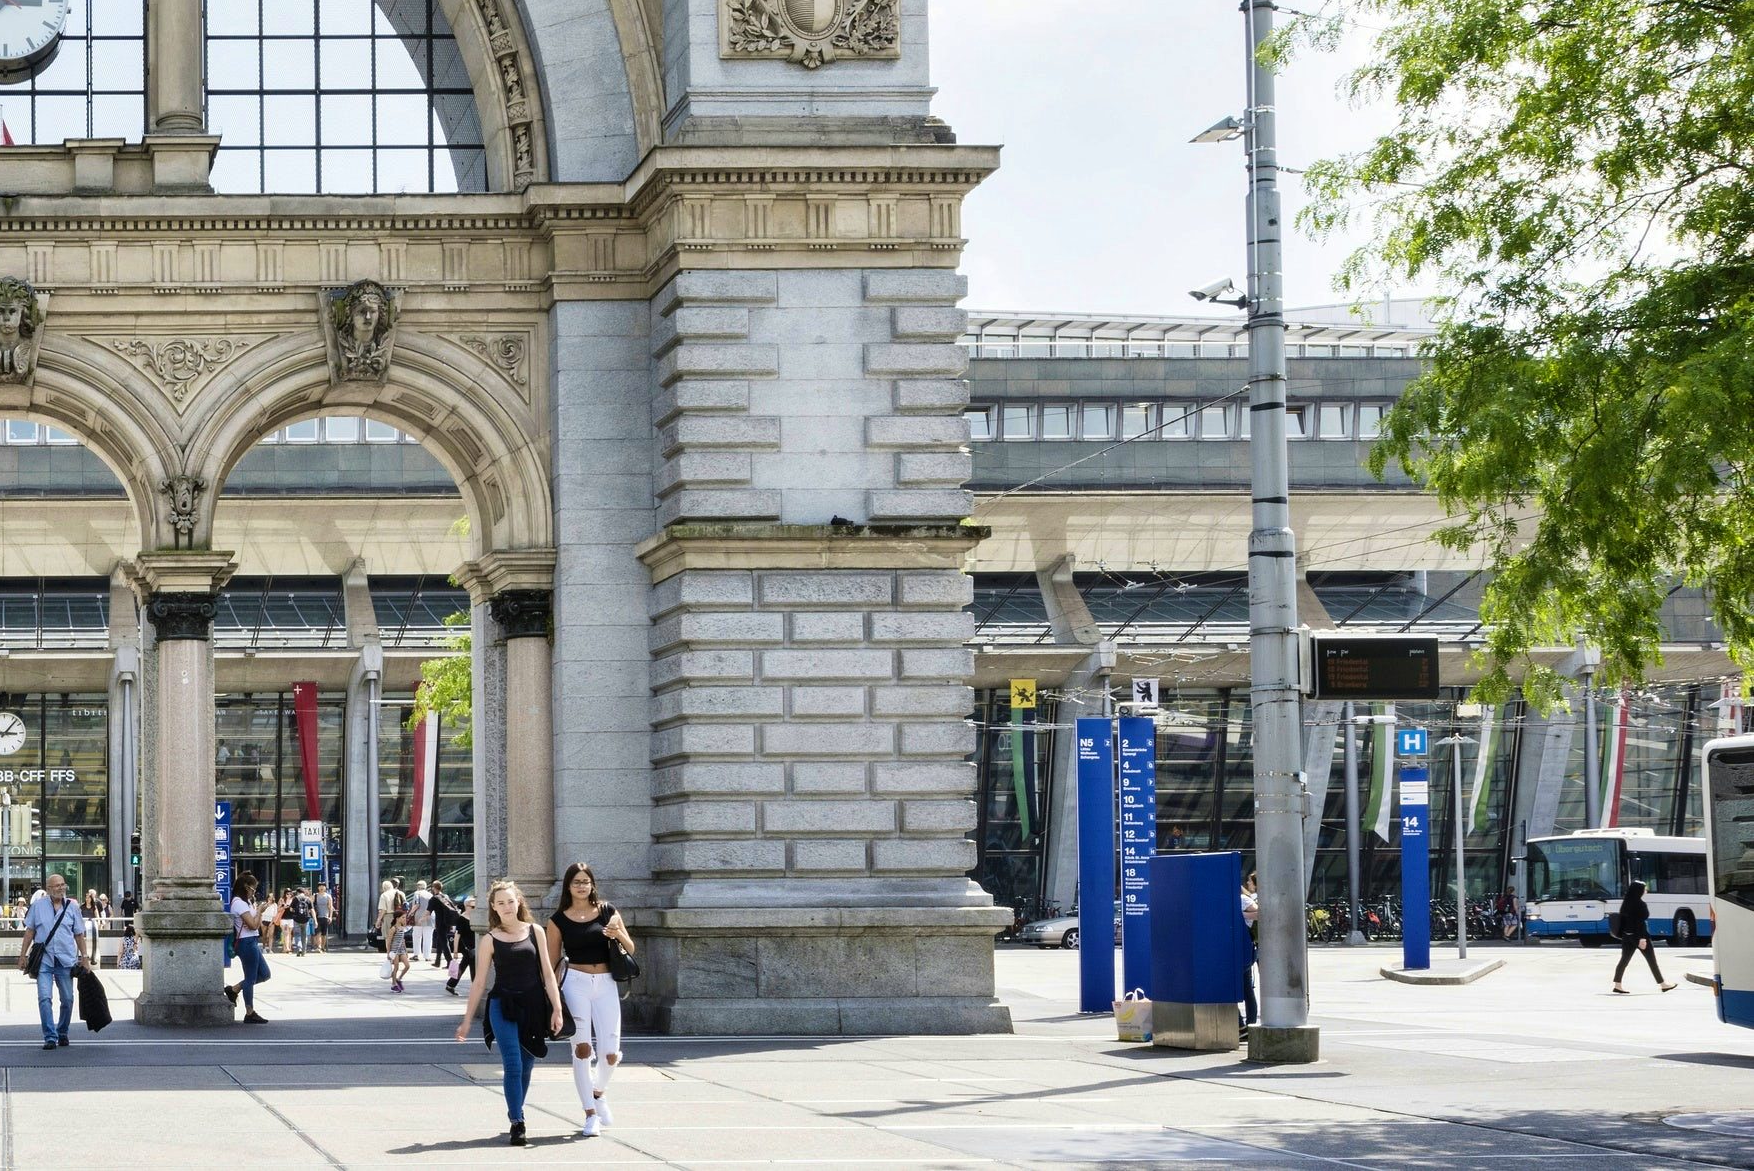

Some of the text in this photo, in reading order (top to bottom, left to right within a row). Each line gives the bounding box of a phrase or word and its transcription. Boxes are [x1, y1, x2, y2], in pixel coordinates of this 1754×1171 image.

[1080, 739, 1093, 747] N5
[1122, 739, 1129, 748] 2
[1404, 734, 1420, 750] H
[1123, 761, 1129, 769] 4
[20, 770, 45, 782] CFF
[50, 770, 75, 782] FFS
[1123, 778, 1129, 786] 9
[1123, 795, 1134, 804] 10
[1124, 813, 1133, 821] 11
[1403, 816, 1418, 827] 14
[304, 827, 320, 835] TAXI
[1124, 830, 1135, 838] 12
[1125, 847, 1135, 855] 14
[1126, 894, 1136, 902] 19
